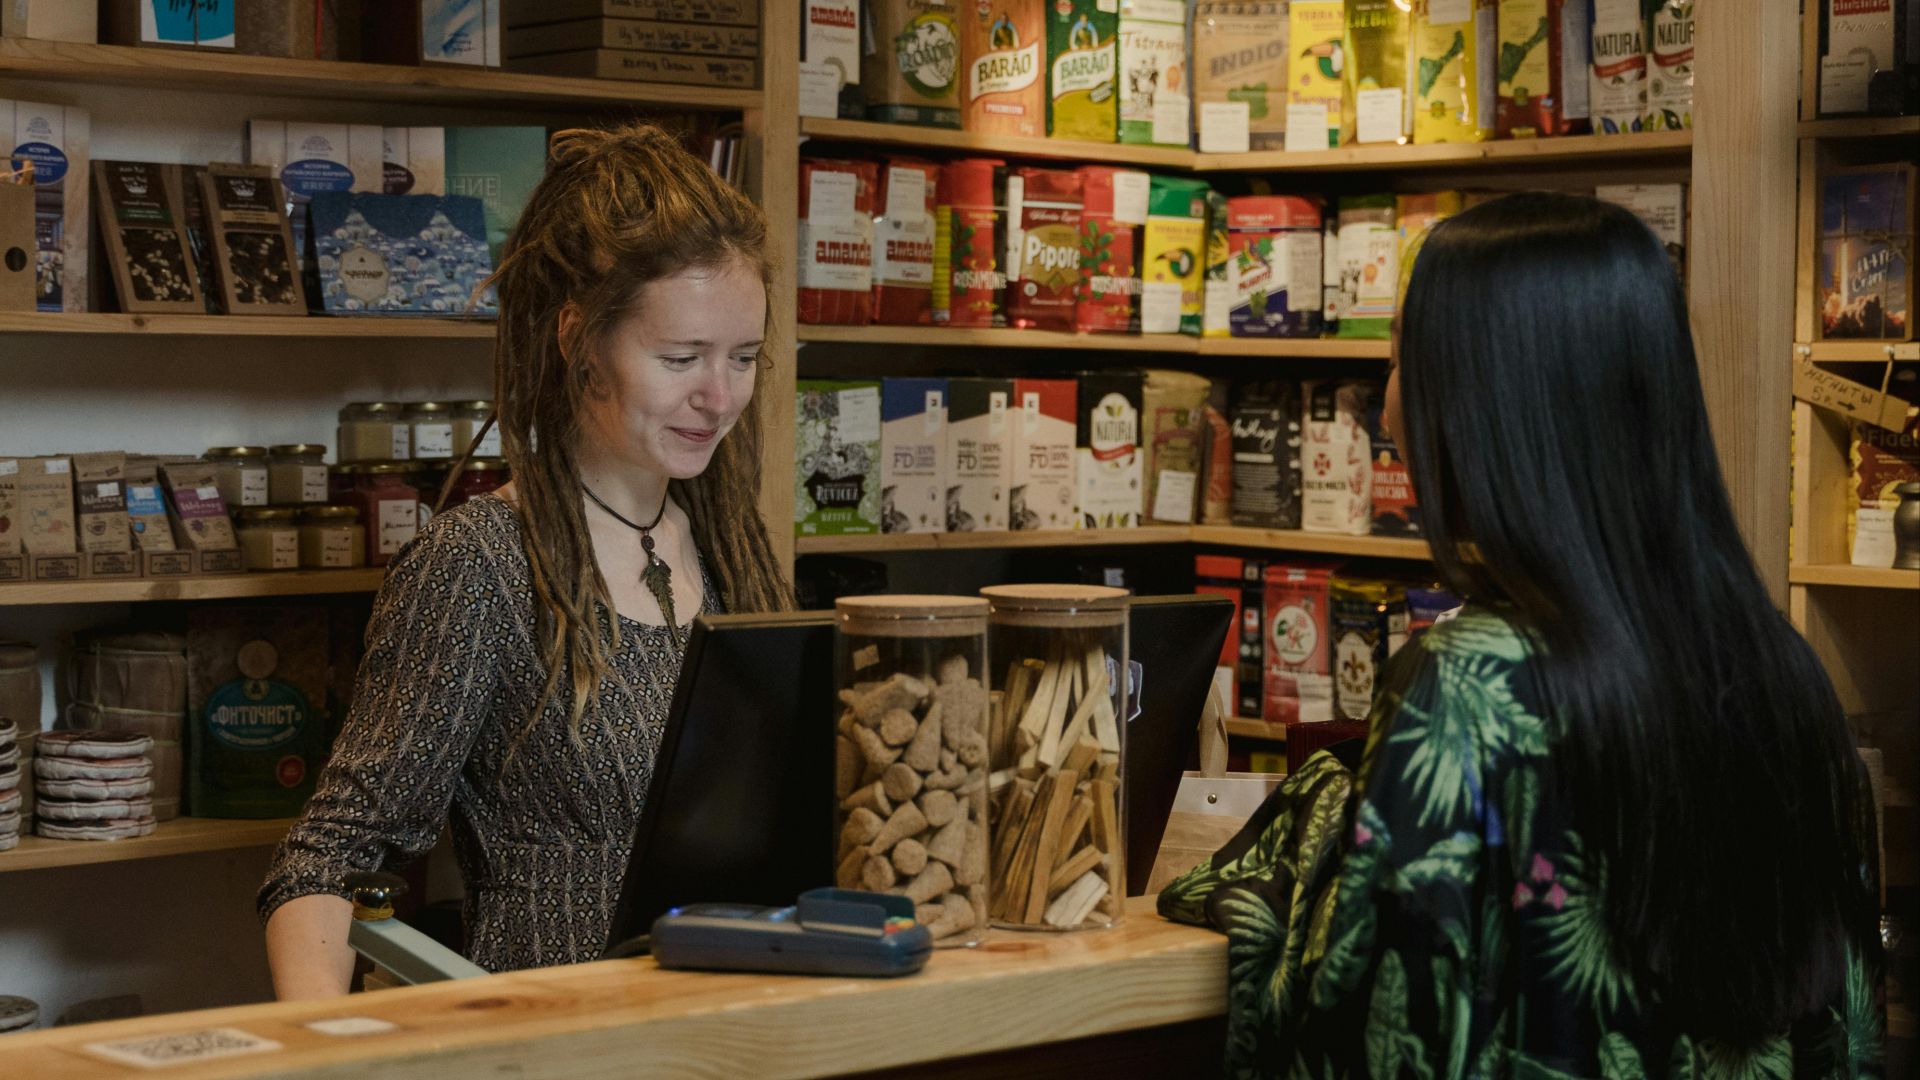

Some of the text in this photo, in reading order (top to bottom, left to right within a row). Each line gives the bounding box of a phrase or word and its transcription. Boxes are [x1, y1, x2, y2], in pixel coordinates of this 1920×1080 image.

[811, 6, 855, 28] amanda
[1595, 33, 1641, 56] NATURA
[979, 53, 1031, 83] BARÃO
[1061, 53, 1109, 81] BARÃO
[1026, 235, 1080, 272] Pipore
[217, 704, 296, 725] ФИТОЧИСТ
